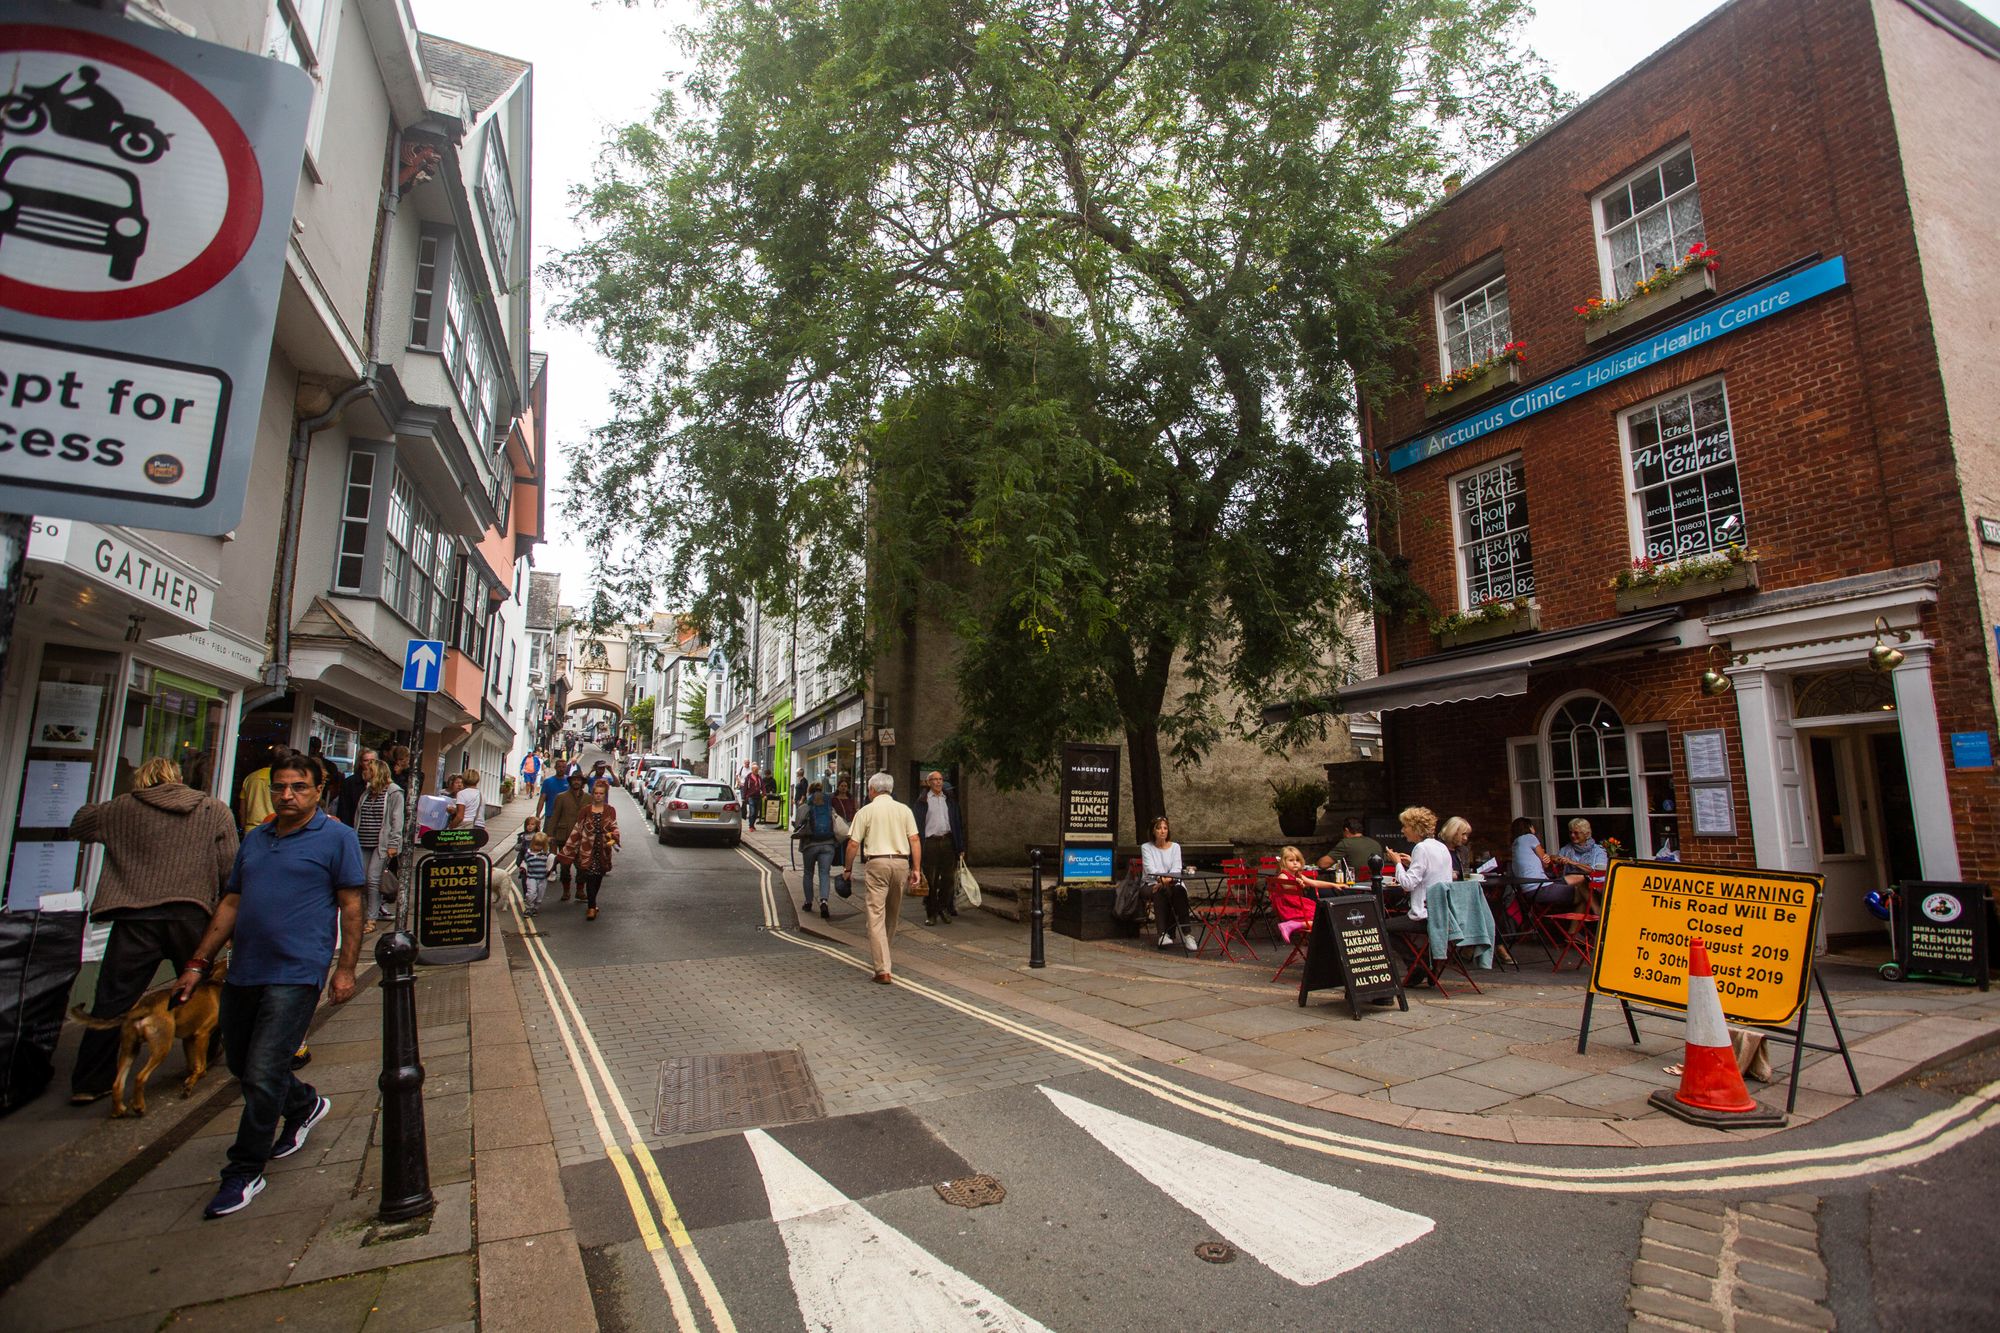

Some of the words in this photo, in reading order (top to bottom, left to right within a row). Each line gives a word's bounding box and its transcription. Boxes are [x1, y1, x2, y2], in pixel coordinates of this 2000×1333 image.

[1428, 412, 1504, 455] Arcturus
[1510, 385, 1566, 418] Clinic
[1587, 351, 1647, 386] Holistic
[1652, 322, 1711, 358] Health
[1719, 290, 1790, 329] Centre
[0, 371, 83, 409] pt
[108, 379, 194, 424] for
[1663, 424, 1690, 438] The
[1633, 431, 1729, 471] Arcturus
[1668, 447, 1727, 475] Clinic
[1468, 464, 1513, 491] OPEN
[1466, 477, 1518, 507] SPACE
[1675, 487, 1700, 498] www.
[1471, 502, 1516, 526] GROUP
[1485, 521, 1505, 535] AND
[1677, 519, 1706, 533] (01803)
[1471, 530, 1529, 558] THERAPY
[1647, 538, 1674, 559] 86
[1680, 531, 1707, 551] 82
[1479, 547, 1520, 570] ROOM
[95, 539, 198, 615] GATHER
[1493, 582, 1512, 599] 82
[1517, 576, 1535, 593] 82
[212, 643, 226, 654] FIELD
[231, 651, 252, 664] KITCHEN
[1070, 796, 1109, 804] BREAKFAST
[1070, 804, 1109, 816] LUNCH
[430, 865, 478, 877] ROLY'S
[429, 877, 478, 888] FUDGE
[1642, 876, 1715, 896] ADVANCE
[1720, 882, 1805, 905] WARNING
[1651, 895, 1681, 910] This
[1687, 898, 1728, 916] Road
[1734, 903, 1767, 921] Will
[1774, 908, 1797, 923] Be
[1342, 929, 1364, 938] FRESHLY
[1687, 918, 1744, 937] Closed
[1937, 928, 1972, 936] MORETTI
[1344, 935, 1380, 947] TAKEAWAY
[1912, 933, 1973, 946] PREMIUM
[1912, 943, 1943, 951] ITALIAN
[1346, 944, 1383, 955] SANDWICHES
[1702, 939, 1743, 955] ugust
[1751, 945, 1789, 962] 2019
[1912, 950, 1943, 959] CHILLED
[1349, 957, 1370, 965] SEASONAL
[1370, 954, 1386, 962] SALADS
[1351, 966, 1372, 974] ORGANIC
[1372, 963, 1389, 971] COFFEE
[1636, 947, 1650, 961] To
[1659, 953, 1688, 969] 30th
[1746, 967, 1783, 985] 2019
[1355, 976, 1369, 987] ALL
[1369, 975, 1379, 984] TO
[1380, 973, 1391, 982] GO
[1633, 967, 1682, 986] 9:30am
